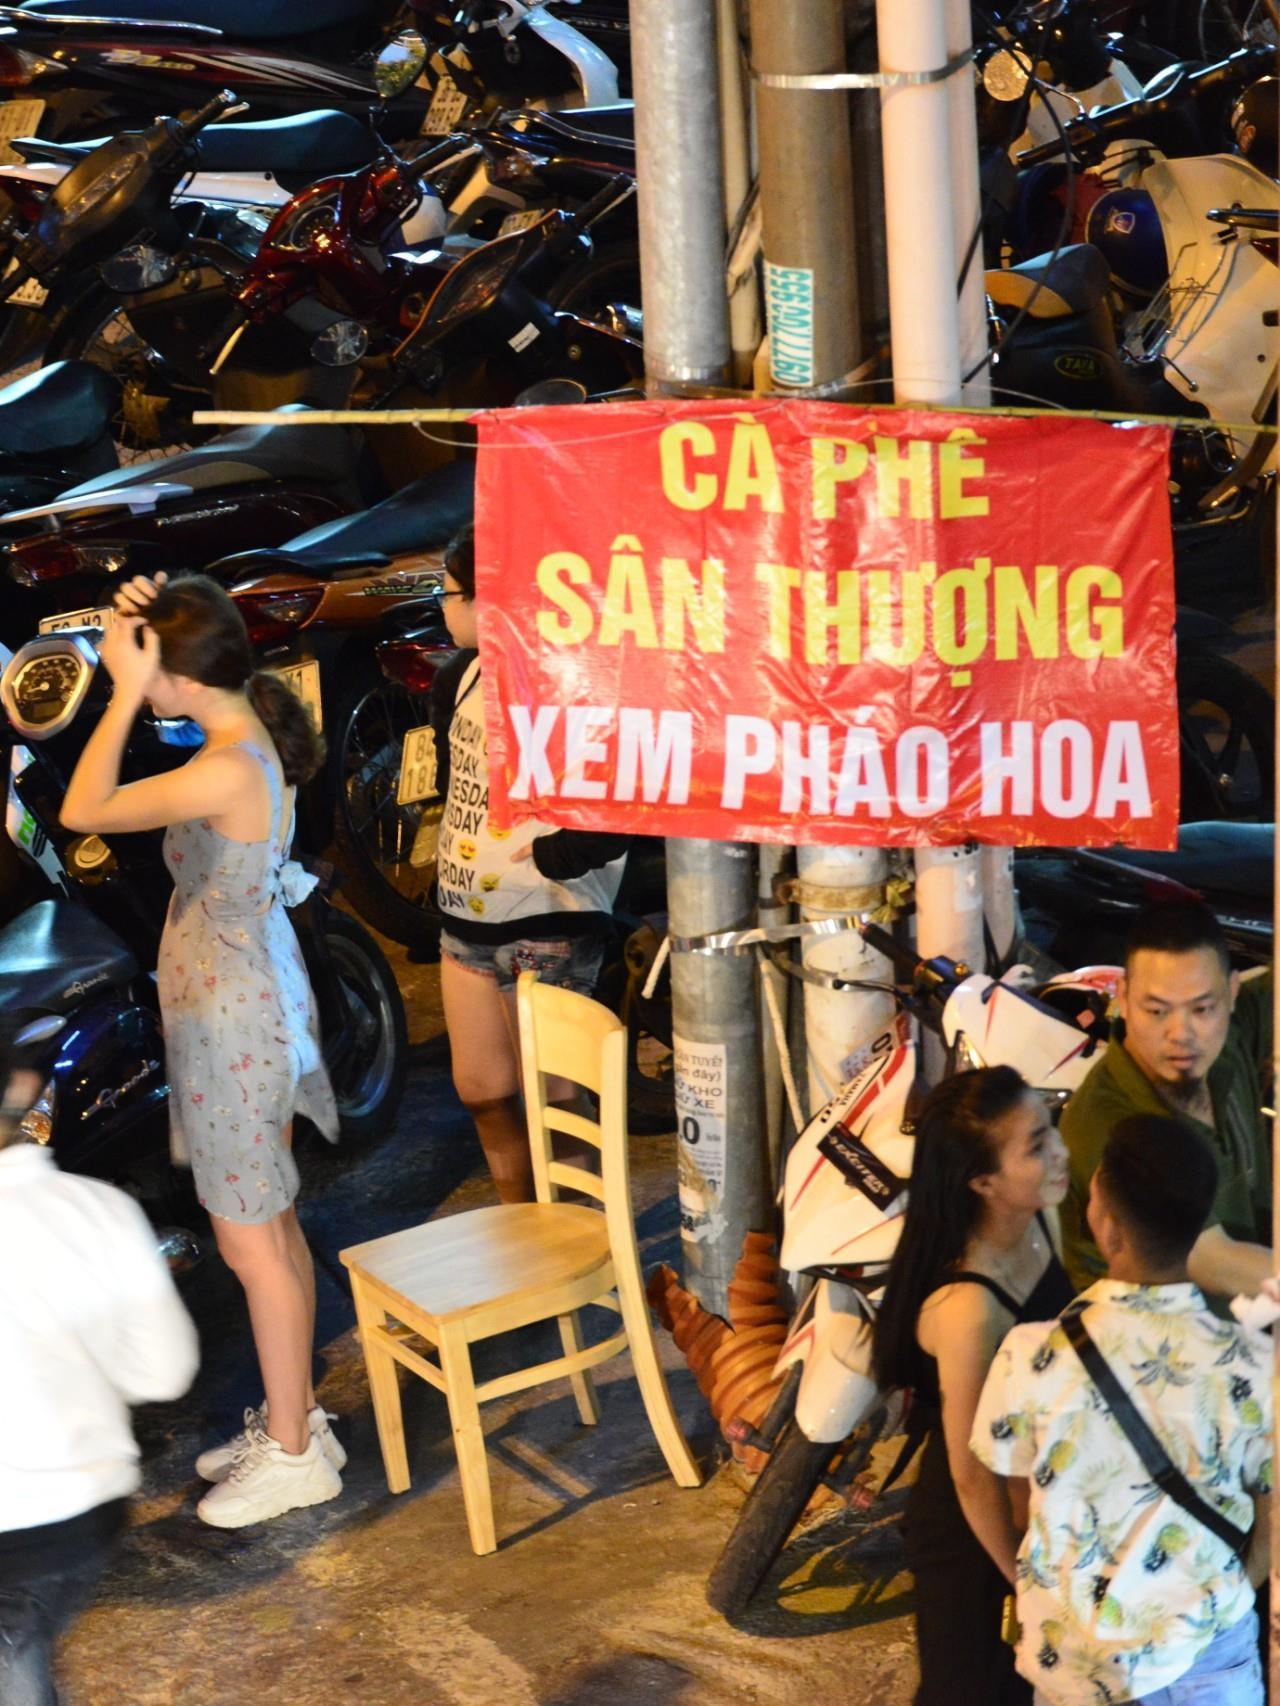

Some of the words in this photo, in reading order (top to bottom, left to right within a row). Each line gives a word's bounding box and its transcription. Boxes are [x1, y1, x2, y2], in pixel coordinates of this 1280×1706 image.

[659, 413, 783, 514] CÀ
[811, 428, 990, 520] PHÊ
[536, 534, 725, 653] SÂN
[756, 557, 1124, 687] THƯỢNG
[508, 705, 693, 806] XEM
[721, 705, 949, 819] PHÁO
[980, 719, 1153, 819] HOA
[688, 1084, 723, 1097] KHO
